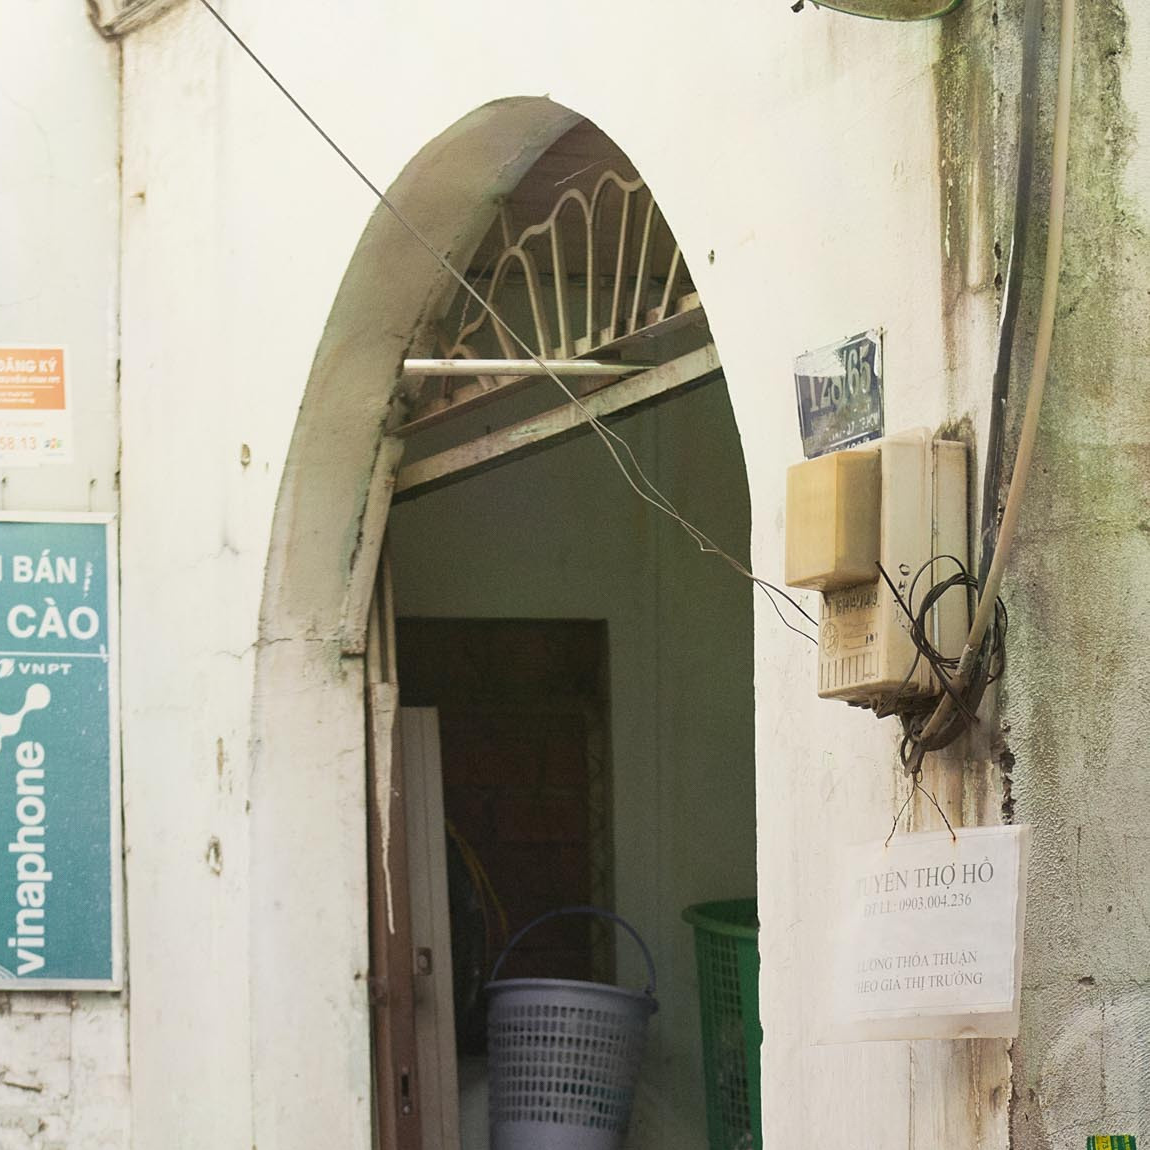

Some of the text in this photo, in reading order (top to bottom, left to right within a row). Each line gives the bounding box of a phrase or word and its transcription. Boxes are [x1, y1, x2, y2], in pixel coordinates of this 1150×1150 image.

[39, 356, 57, 372] KÝ
[13, 549, 77, 583] BÁN
[7, 597, 99, 639] CÀO
[18, 662, 72, 675] VNPT
[8, 740, 52, 977] vinaphone
[914, 863, 956, 890] THỢ
[962, 856, 994, 884] HỒ
[899, 893, 972, 912] 0903.004.236
[932, 949, 977, 967] THUẬN
[904, 975, 925, 992] THỊ
[929, 971, 983, 989] TRƯỜNG
